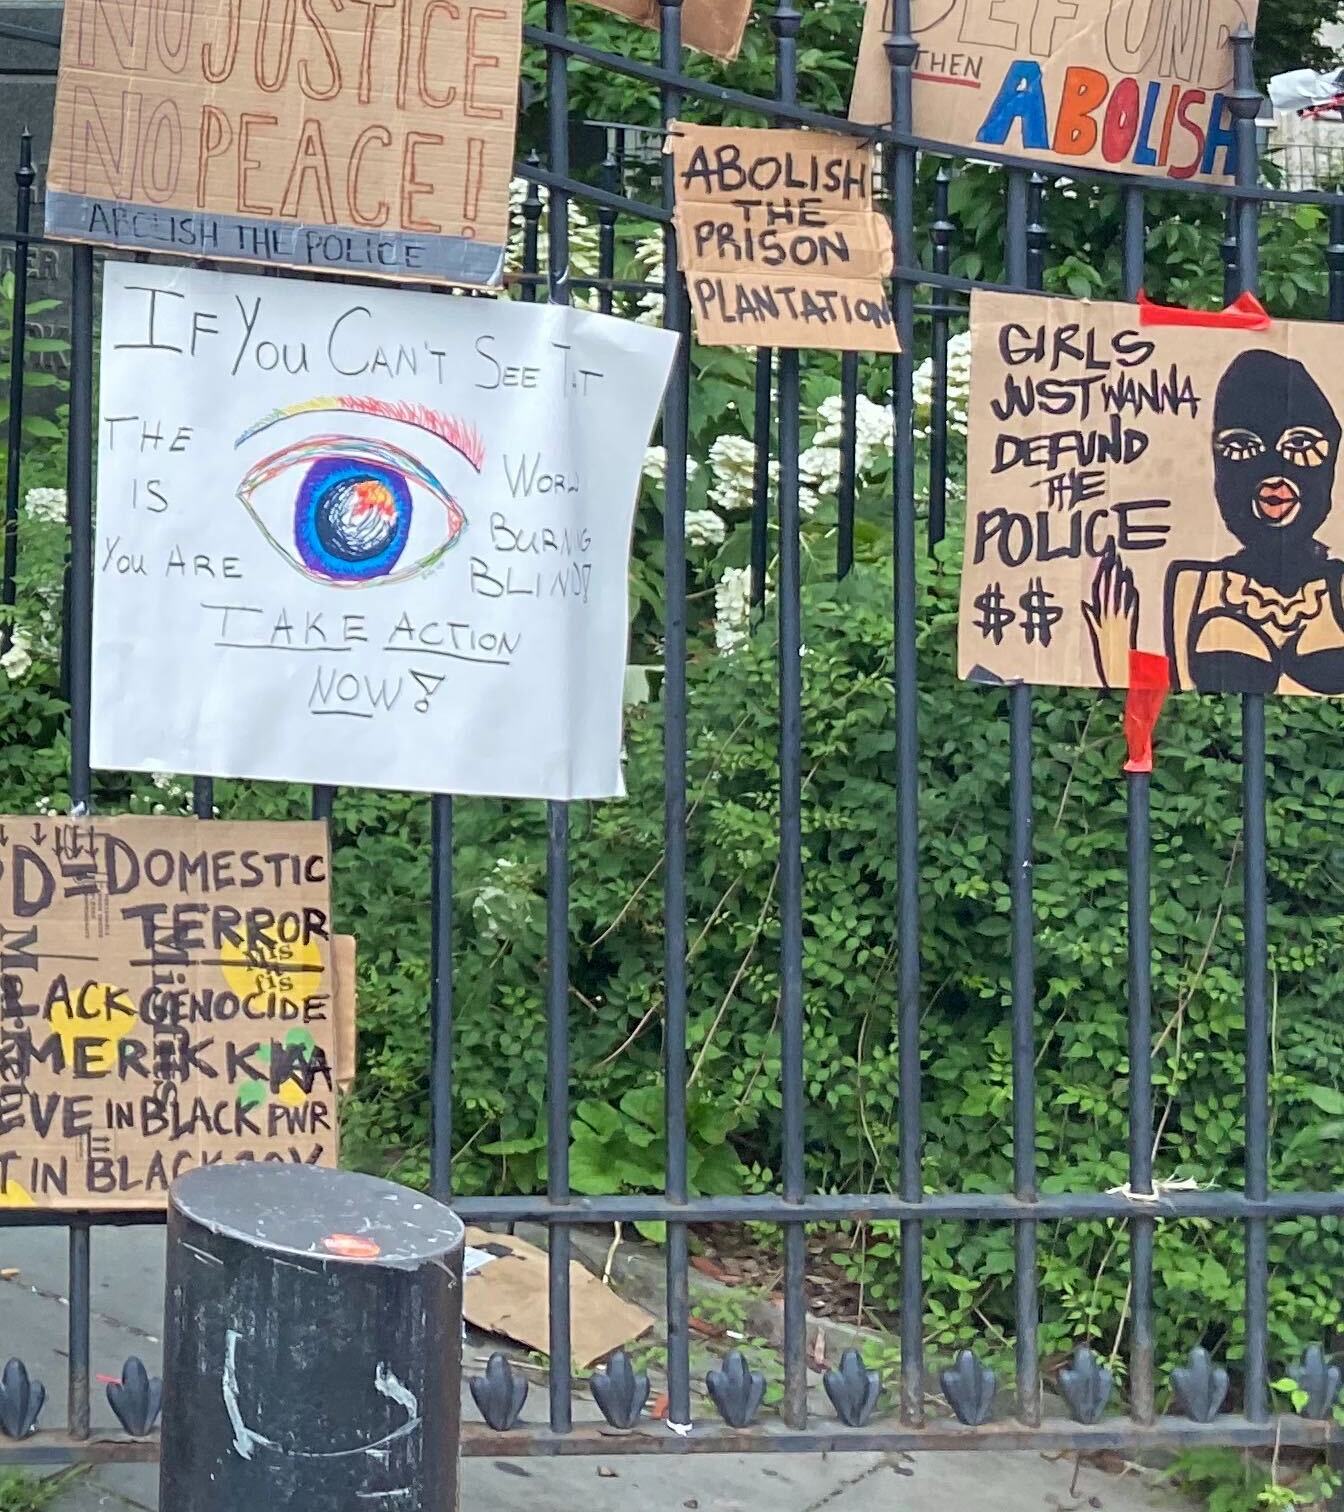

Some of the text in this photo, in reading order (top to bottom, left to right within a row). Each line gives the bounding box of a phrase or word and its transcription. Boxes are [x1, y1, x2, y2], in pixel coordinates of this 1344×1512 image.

[914, 49, 983, 79] THEN
[976, 59, 1236, 180] ABOLISH
[67, 85, 486, 239] NO PEACE!
[681, 143, 867, 195] ABOLISH
[735, 198, 826, 227] THE
[234, 226, 295, 257] THE
[305, 230, 426, 269] POLICE
[695, 219, 849, 265] PRISON
[695, 277, 892, 328] PLANTATION
[115, 286, 218, 356] IF
[475, 335, 540, 390] SEE
[999, 324, 1155, 371] GIRLS
[991, 364, 1201, 421] JUST WANNA
[105, 417, 193, 452] THE
[992, 414, 1149, 474] DEFUND
[133, 479, 168, 513] IS
[1031, 469, 1106, 511] THE
[973, 499, 1171, 566] POLICE
[165, 545, 243, 580] ARE
[201, 604, 521, 655] TAKE ACTION
[105, 836, 326, 895] DOMESTIC
[120, 902, 330, 951] TERROR
[140, 987, 330, 1026] GENOCIDE
[106, 1098, 134, 1128] IN
[140, 1094, 262, 1141] BLACK
[267, 1099, 332, 1136] PWR
[31, 1156, 68, 1195] IN
